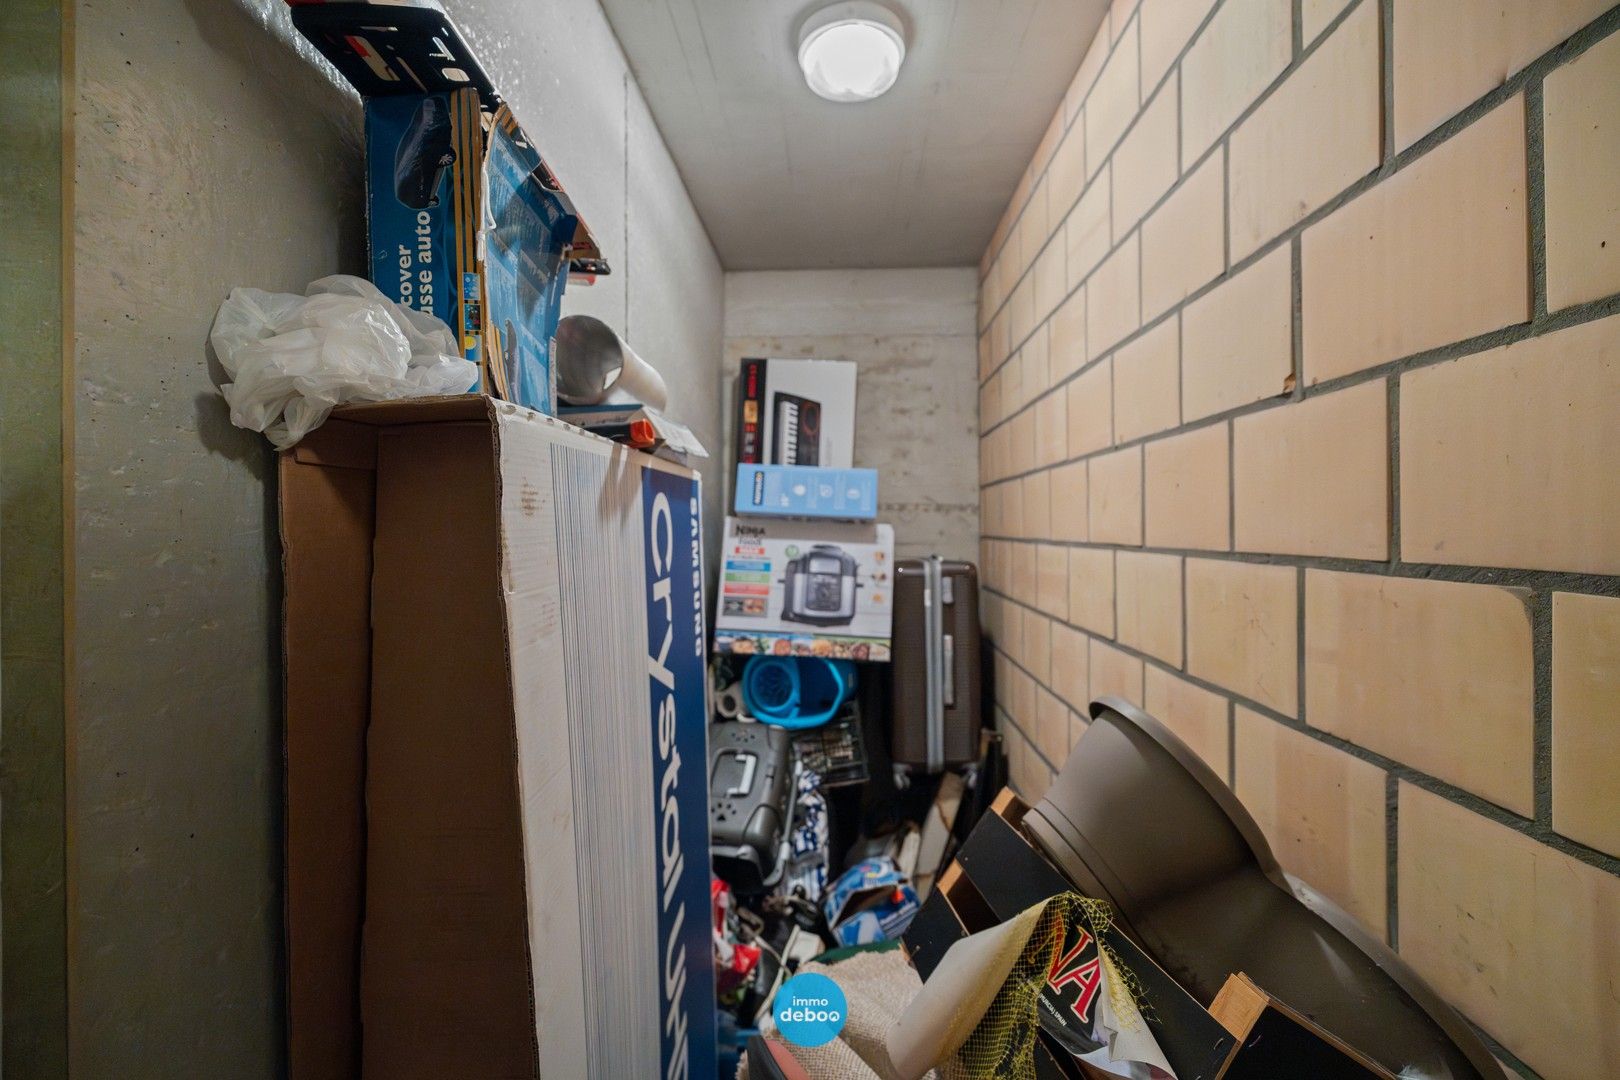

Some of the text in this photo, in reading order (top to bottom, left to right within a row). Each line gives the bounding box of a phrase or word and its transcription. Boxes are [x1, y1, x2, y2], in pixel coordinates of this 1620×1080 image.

[398, 244, 413, 308] cover
[414, 211, 433, 264] auto
[689, 496, 702, 657] SAMSUNG
[649, 492, 683, 912] Crystal
